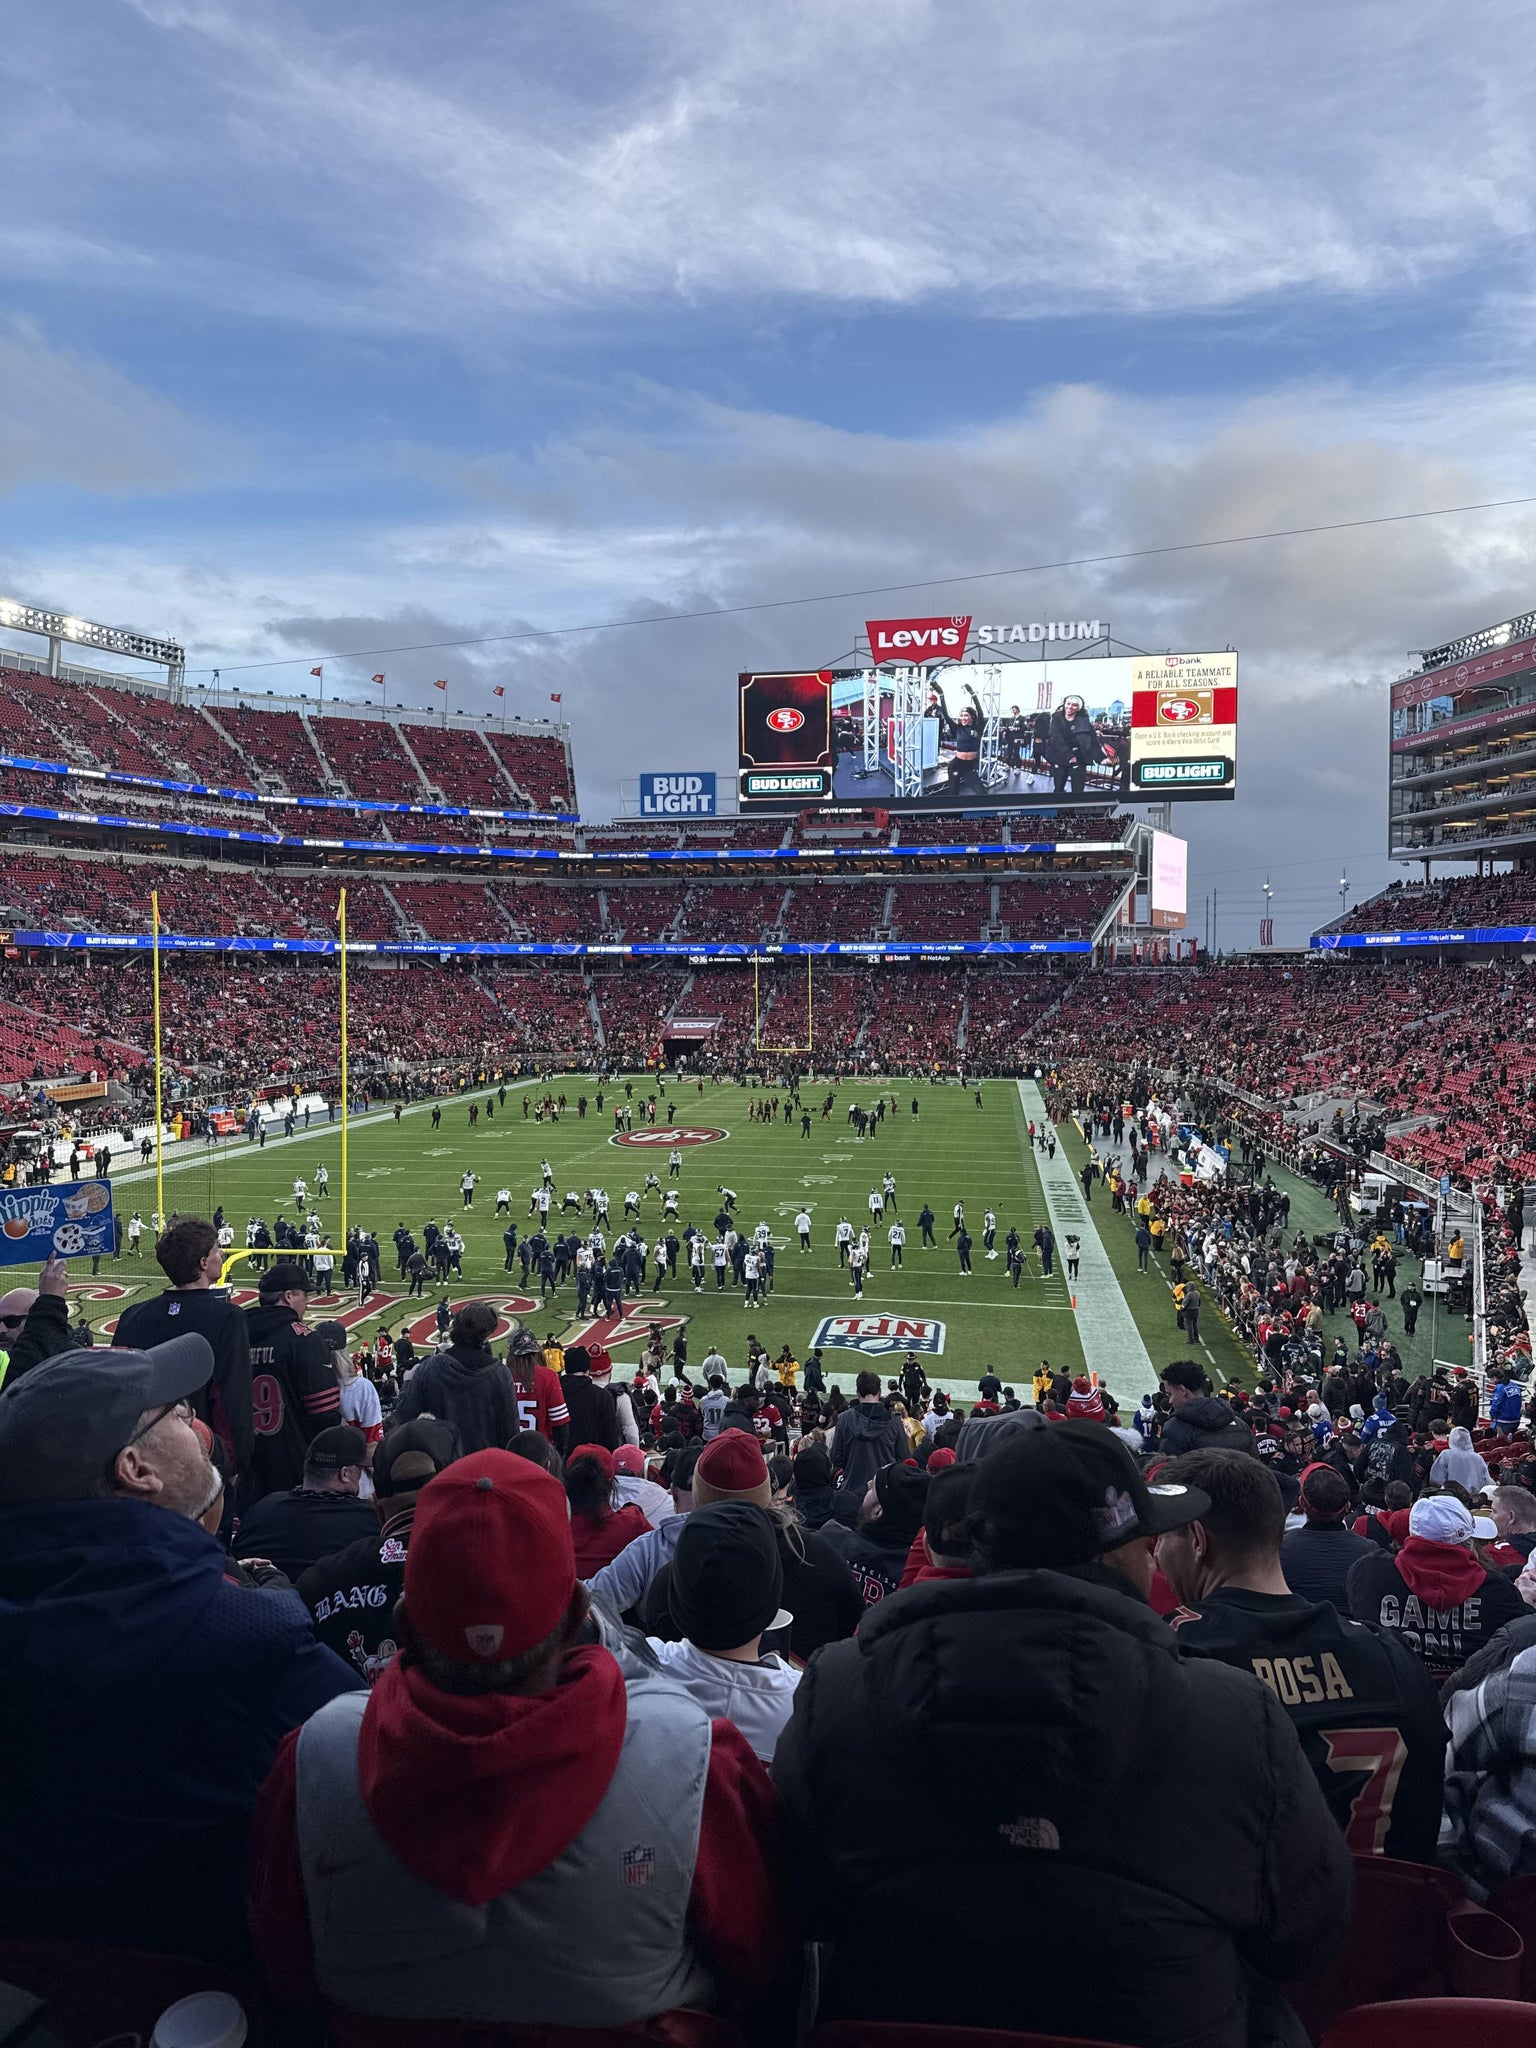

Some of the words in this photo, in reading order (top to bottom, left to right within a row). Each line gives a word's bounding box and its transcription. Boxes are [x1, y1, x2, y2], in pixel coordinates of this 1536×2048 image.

[978, 620, 1101, 645] STADIUM
[1179, 656, 1202, 664] bank
[1138, 671, 1143, 680] A
[1145, 669, 1184, 679] RELIABLE
[1186, 667, 1232, 677] TEAMMATE
[1147, 680, 1163, 689] FOR
[1165, 679, 1180, 688] ALL
[1176, 730, 1200, 739] checking
[1143, 766, 1176, 779] BUD
[653, 777, 703, 795] BUD
[751, 779, 780, 790] BUD
[643, 795, 712, 813] LIGHT
[272, 941, 288, 949] xfinity
[1029, 943, 1047, 951] xfinity
[28, 1214, 54, 1229] dots
[843, 1228, 849, 1237] 7
[715, 1249, 725, 1257] 57
[1355, 1307, 1366, 1317] 23
[835, 1318, 930, 1338] NFL
[315, 1584, 388, 1623] BANG
[1380, 1594, 1482, 1630] GAME
[1251, 1652, 1354, 1705] BOSA
[1317, 1727, 1409, 1854] 7
[628, 1863, 649, 1885] NFL
